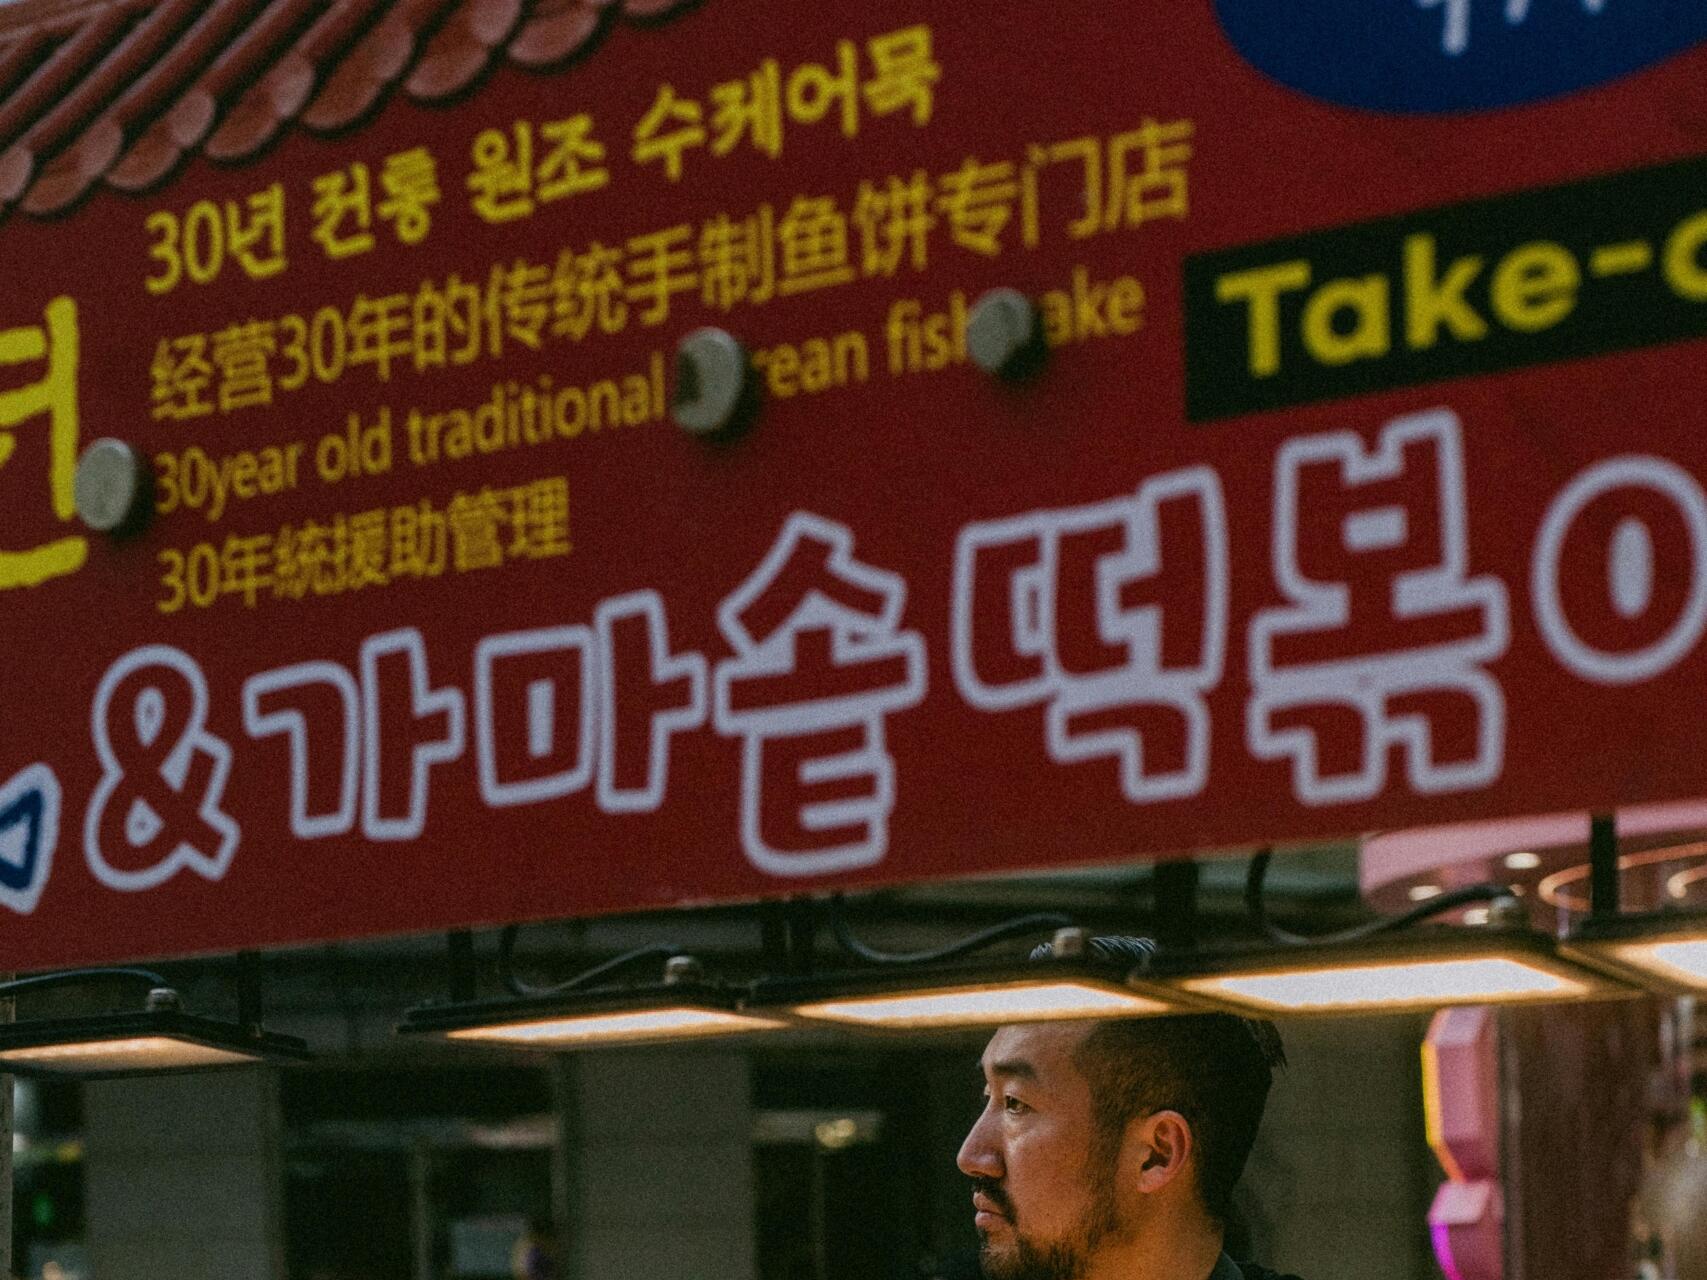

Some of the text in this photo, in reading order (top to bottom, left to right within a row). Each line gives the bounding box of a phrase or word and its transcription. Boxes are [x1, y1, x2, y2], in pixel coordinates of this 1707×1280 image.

[146, 184, 288, 294] 30년
[467, 114, 609, 224] 원조
[155, 442, 304, 521] 30year
[315, 406, 392, 484] old
[406, 352, 665, 468] traditional
[1042, 264, 1147, 348] ake
